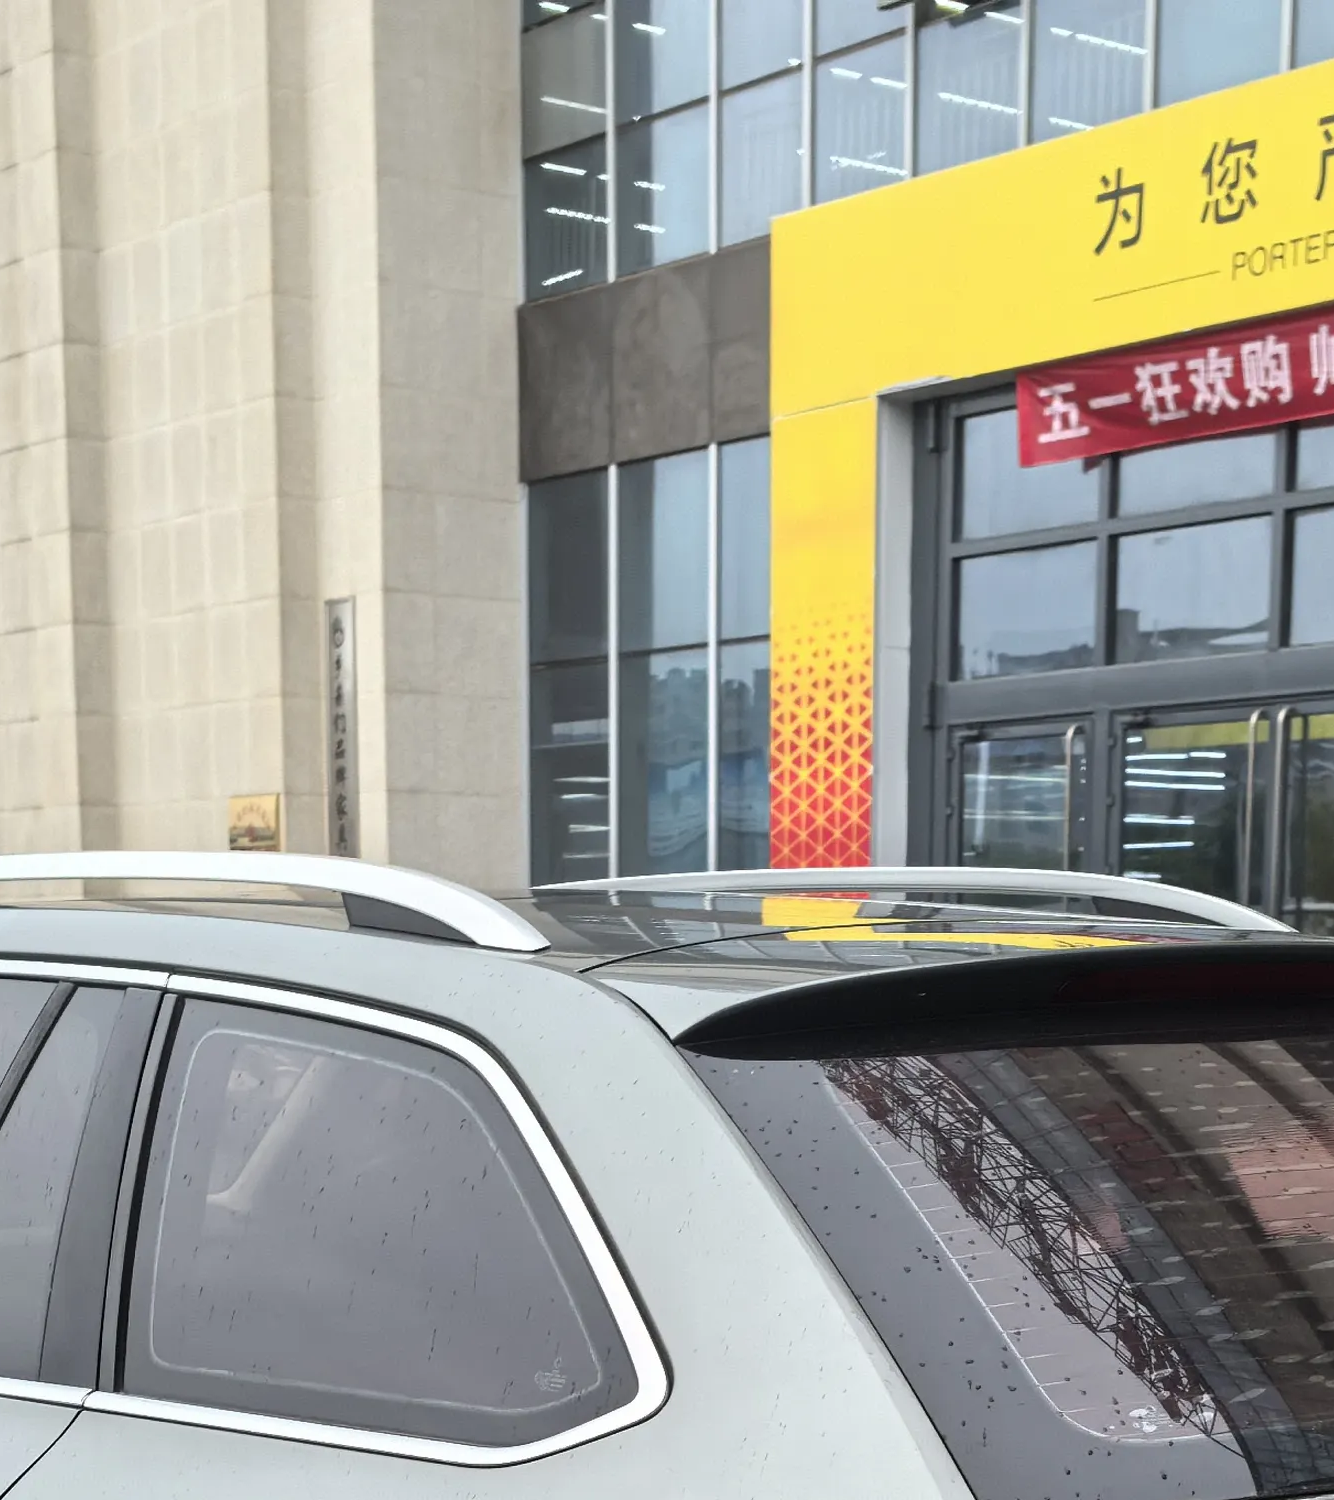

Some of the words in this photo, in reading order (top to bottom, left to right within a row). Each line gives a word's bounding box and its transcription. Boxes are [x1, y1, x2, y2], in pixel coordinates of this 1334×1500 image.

[1037, 334, 1295, 444] 五一狂欢购
